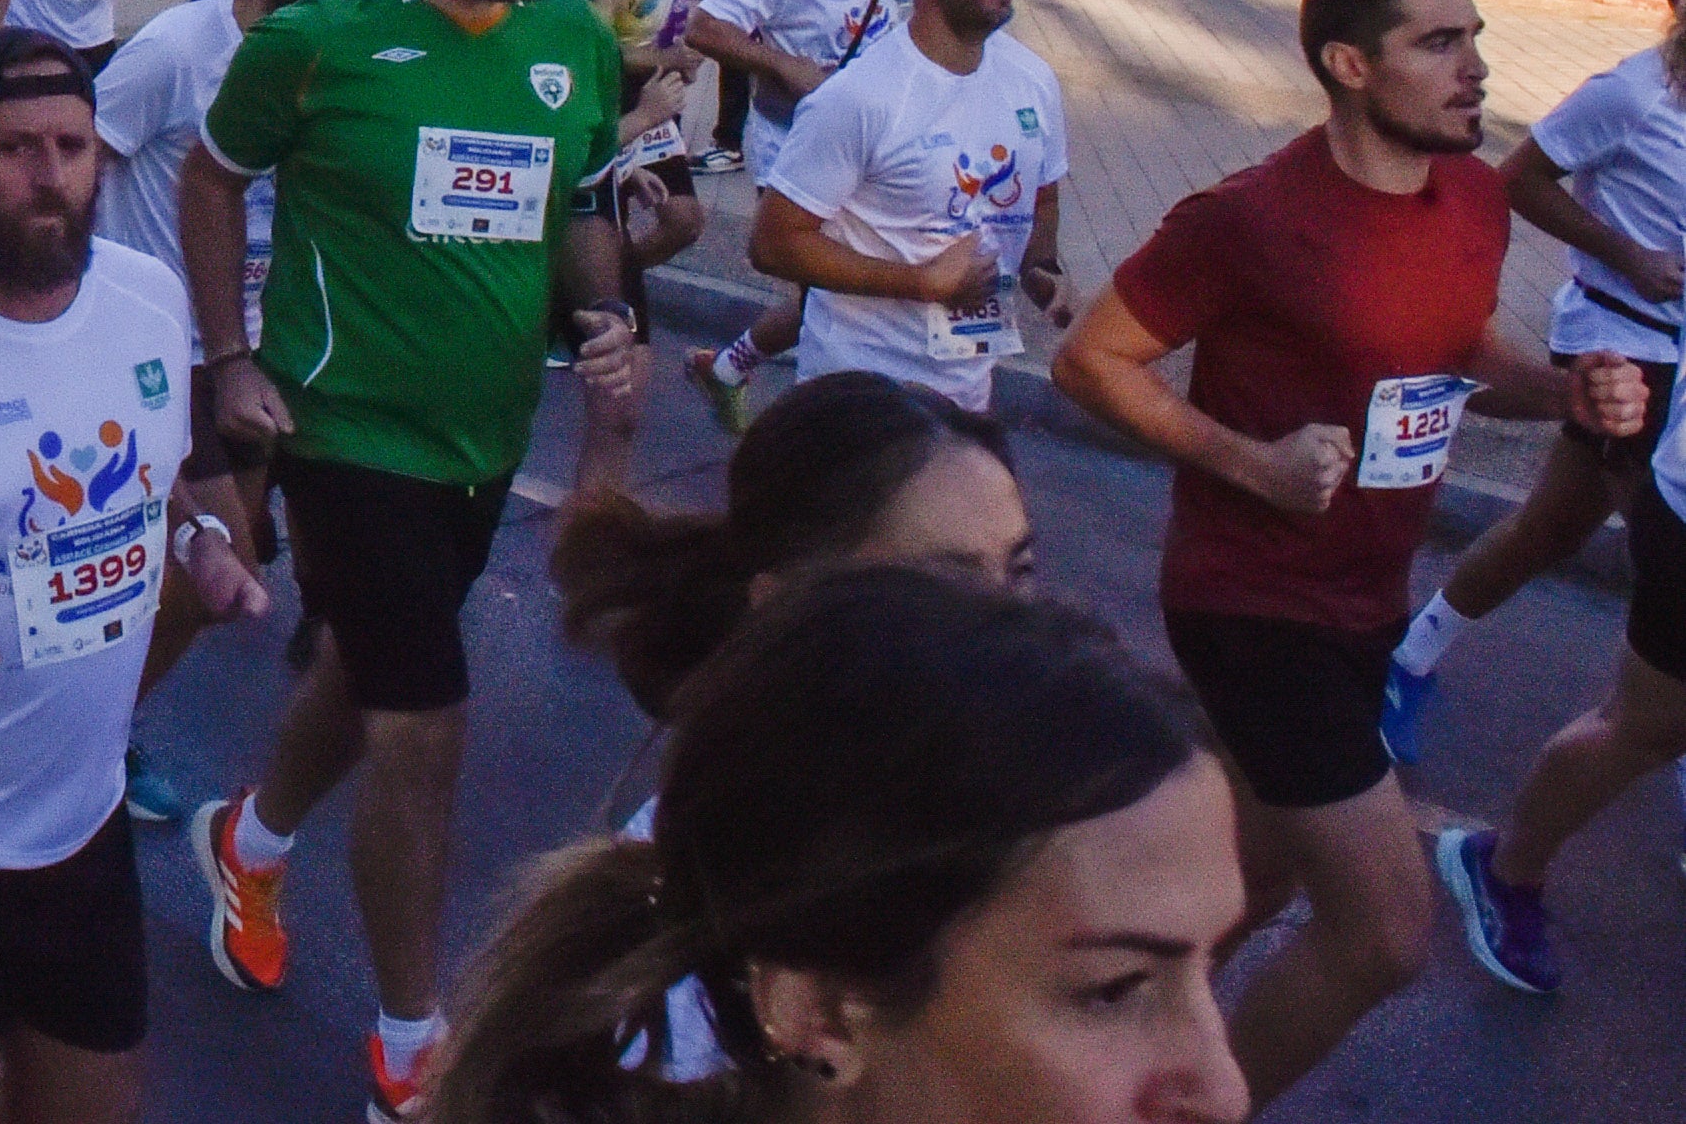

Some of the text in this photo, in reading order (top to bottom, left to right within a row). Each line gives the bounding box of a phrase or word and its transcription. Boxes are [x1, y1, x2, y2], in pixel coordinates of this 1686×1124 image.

[452, 166, 514, 195] 291
[1396, 405, 1451, 441] 1221
[47, 543, 147, 605] 1399
